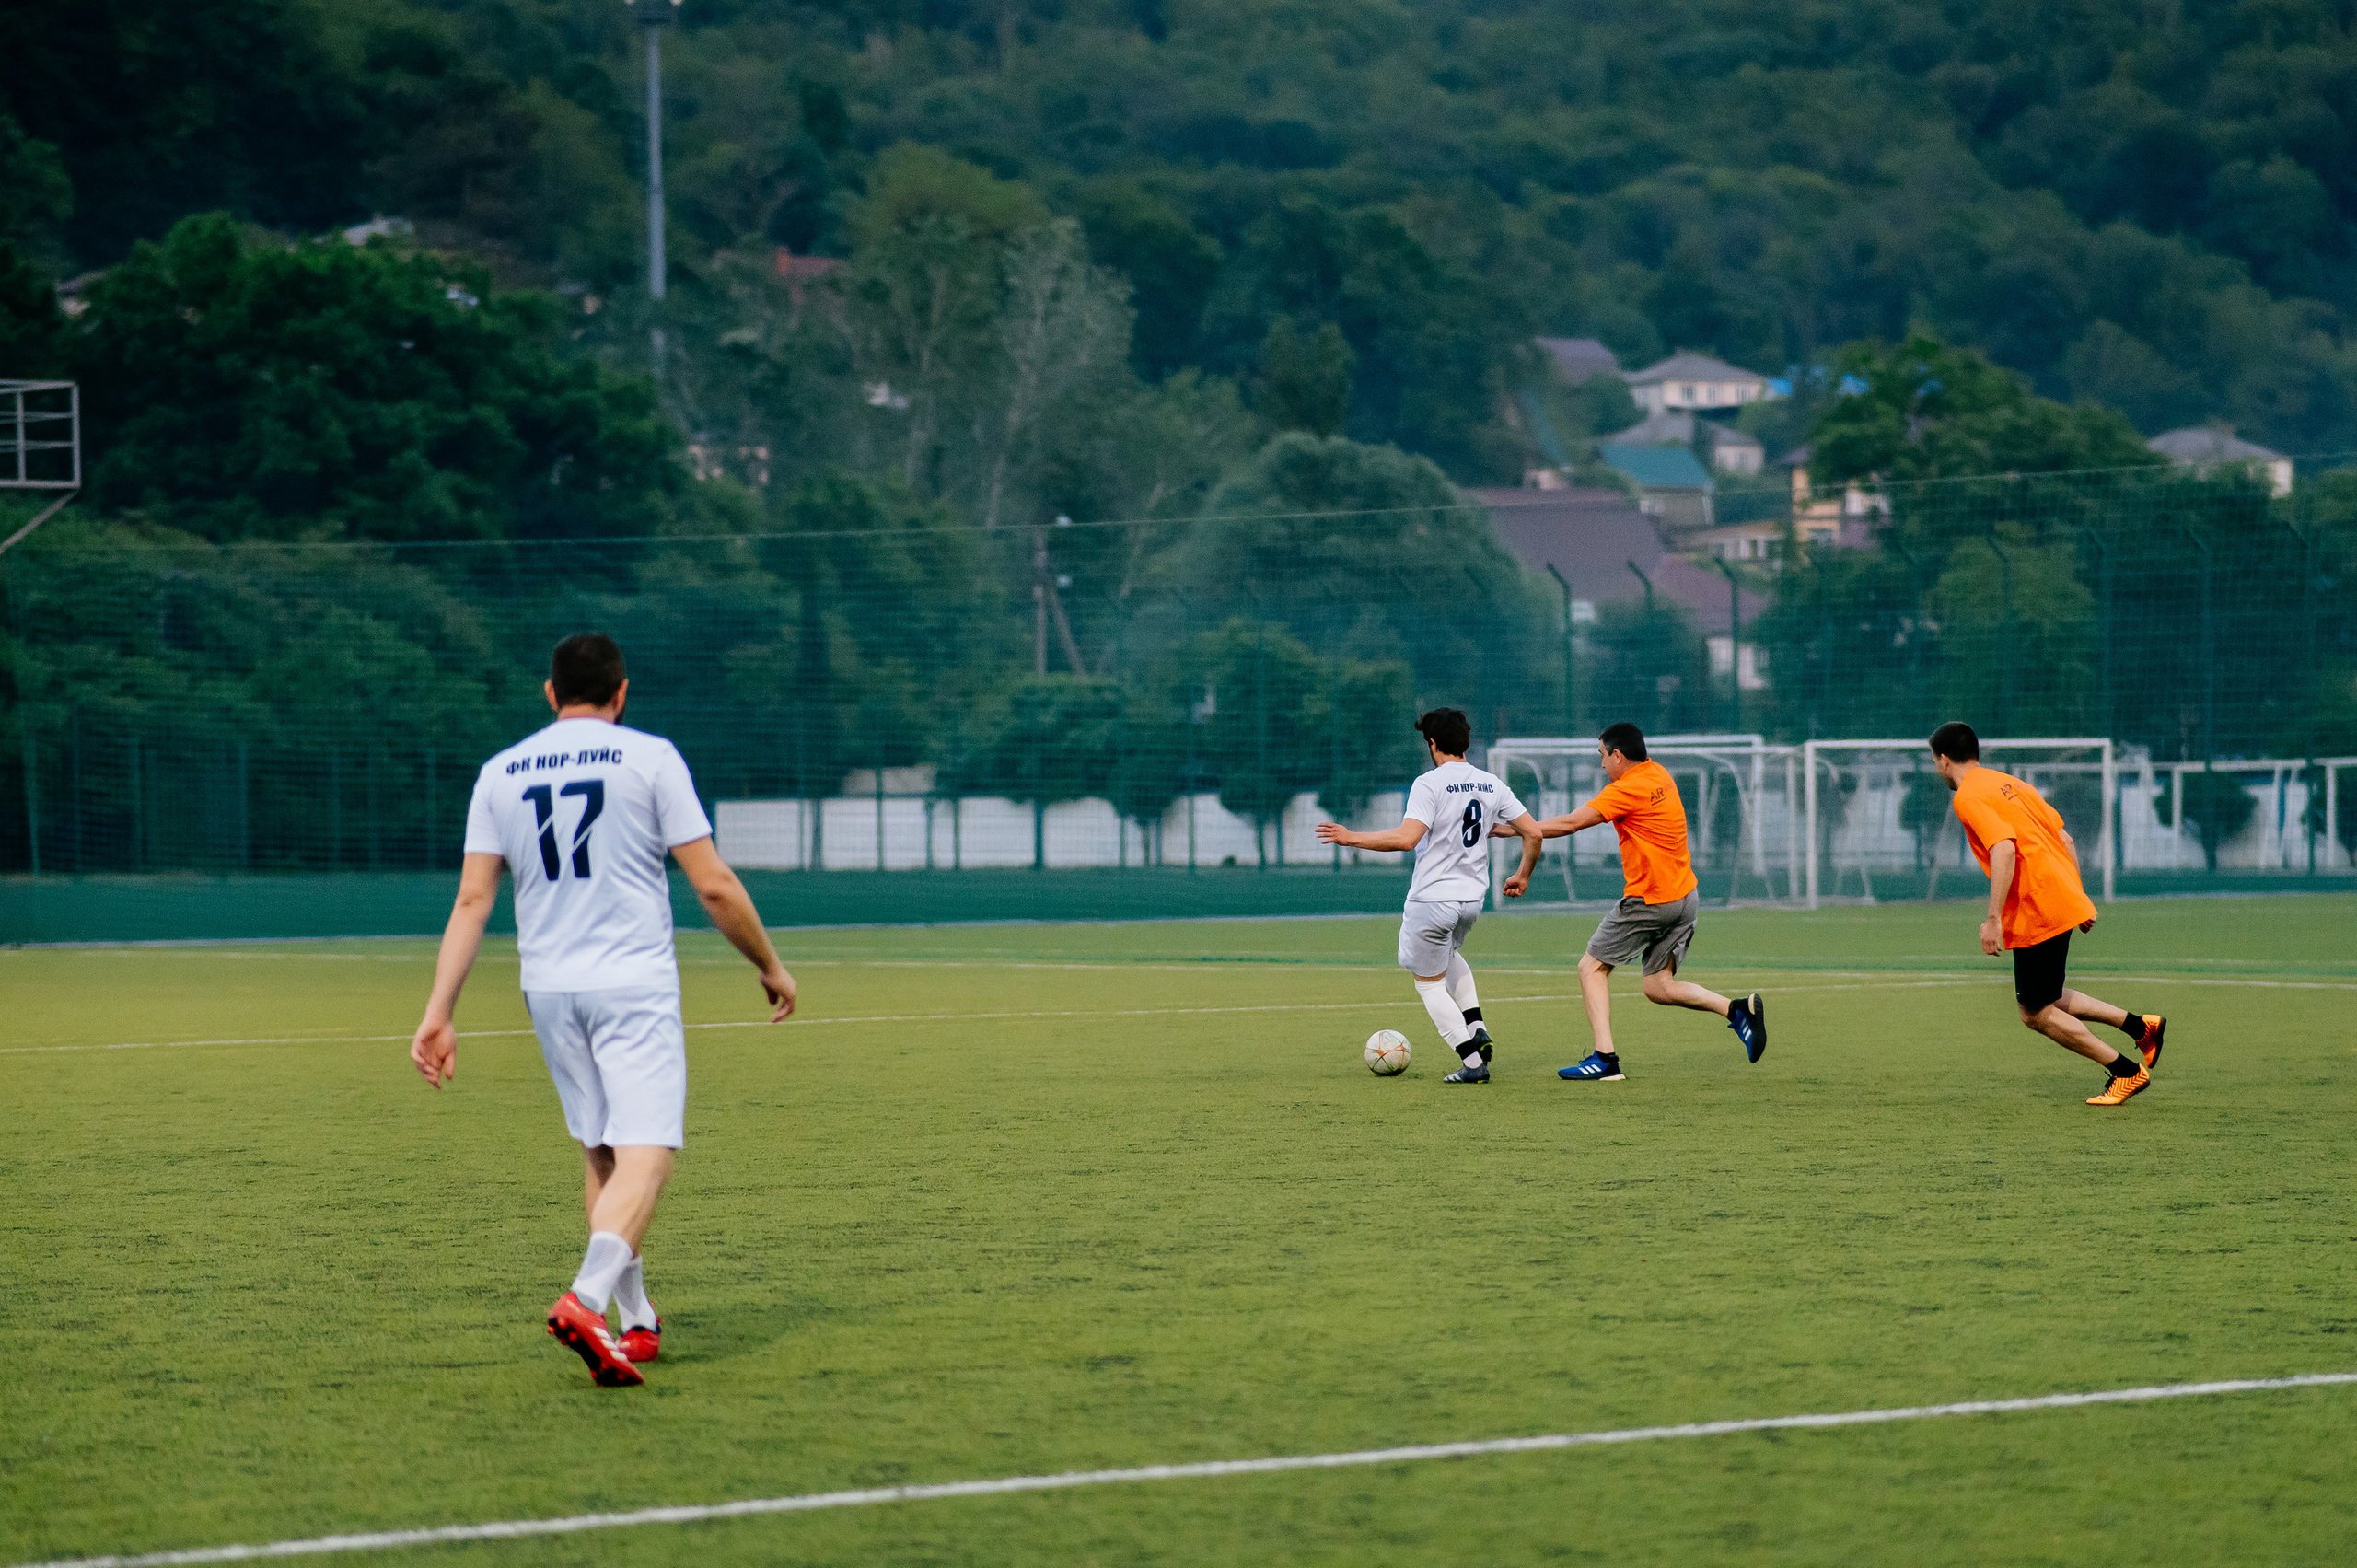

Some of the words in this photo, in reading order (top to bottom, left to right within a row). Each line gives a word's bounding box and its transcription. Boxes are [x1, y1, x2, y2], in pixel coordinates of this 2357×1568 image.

[506, 757, 531, 775] ФК
[1446, 783, 1459, 793] ФК
[521, 779, 606, 881] 17
[1461, 798, 1482, 848] 8
